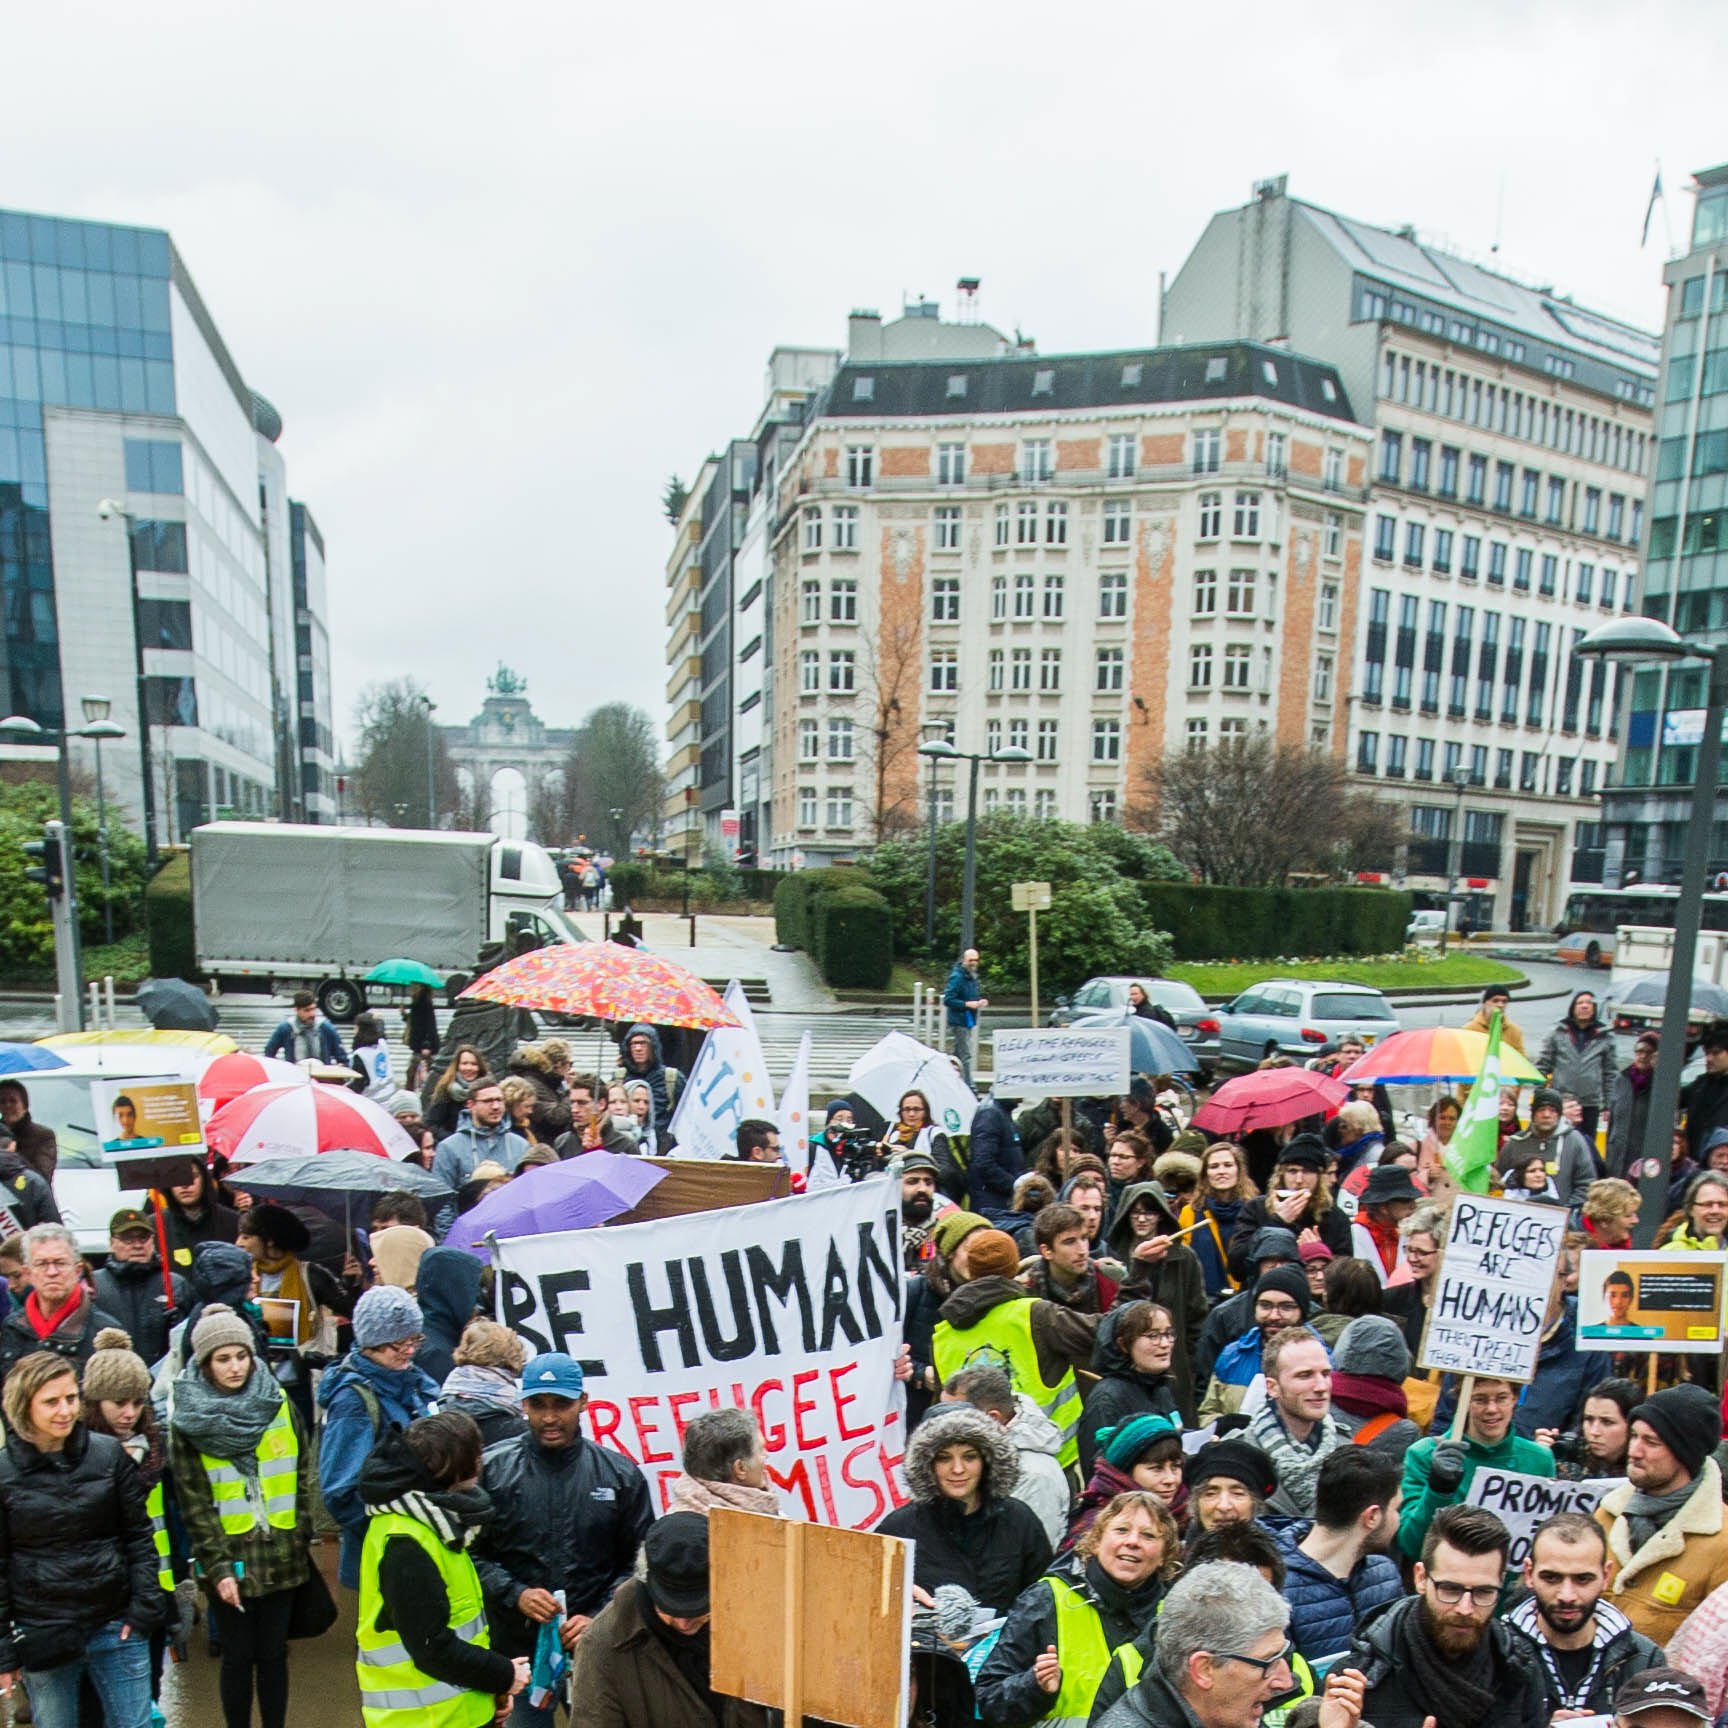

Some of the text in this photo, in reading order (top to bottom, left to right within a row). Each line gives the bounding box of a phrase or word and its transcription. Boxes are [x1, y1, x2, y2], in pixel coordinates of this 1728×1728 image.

[1451, 1203, 1564, 1259] REFUGEES
[1479, 1250, 1521, 1279] ARE
[499, 1209, 902, 1378] BE HUMAN
[1438, 1278, 1544, 1335] HUMANS
